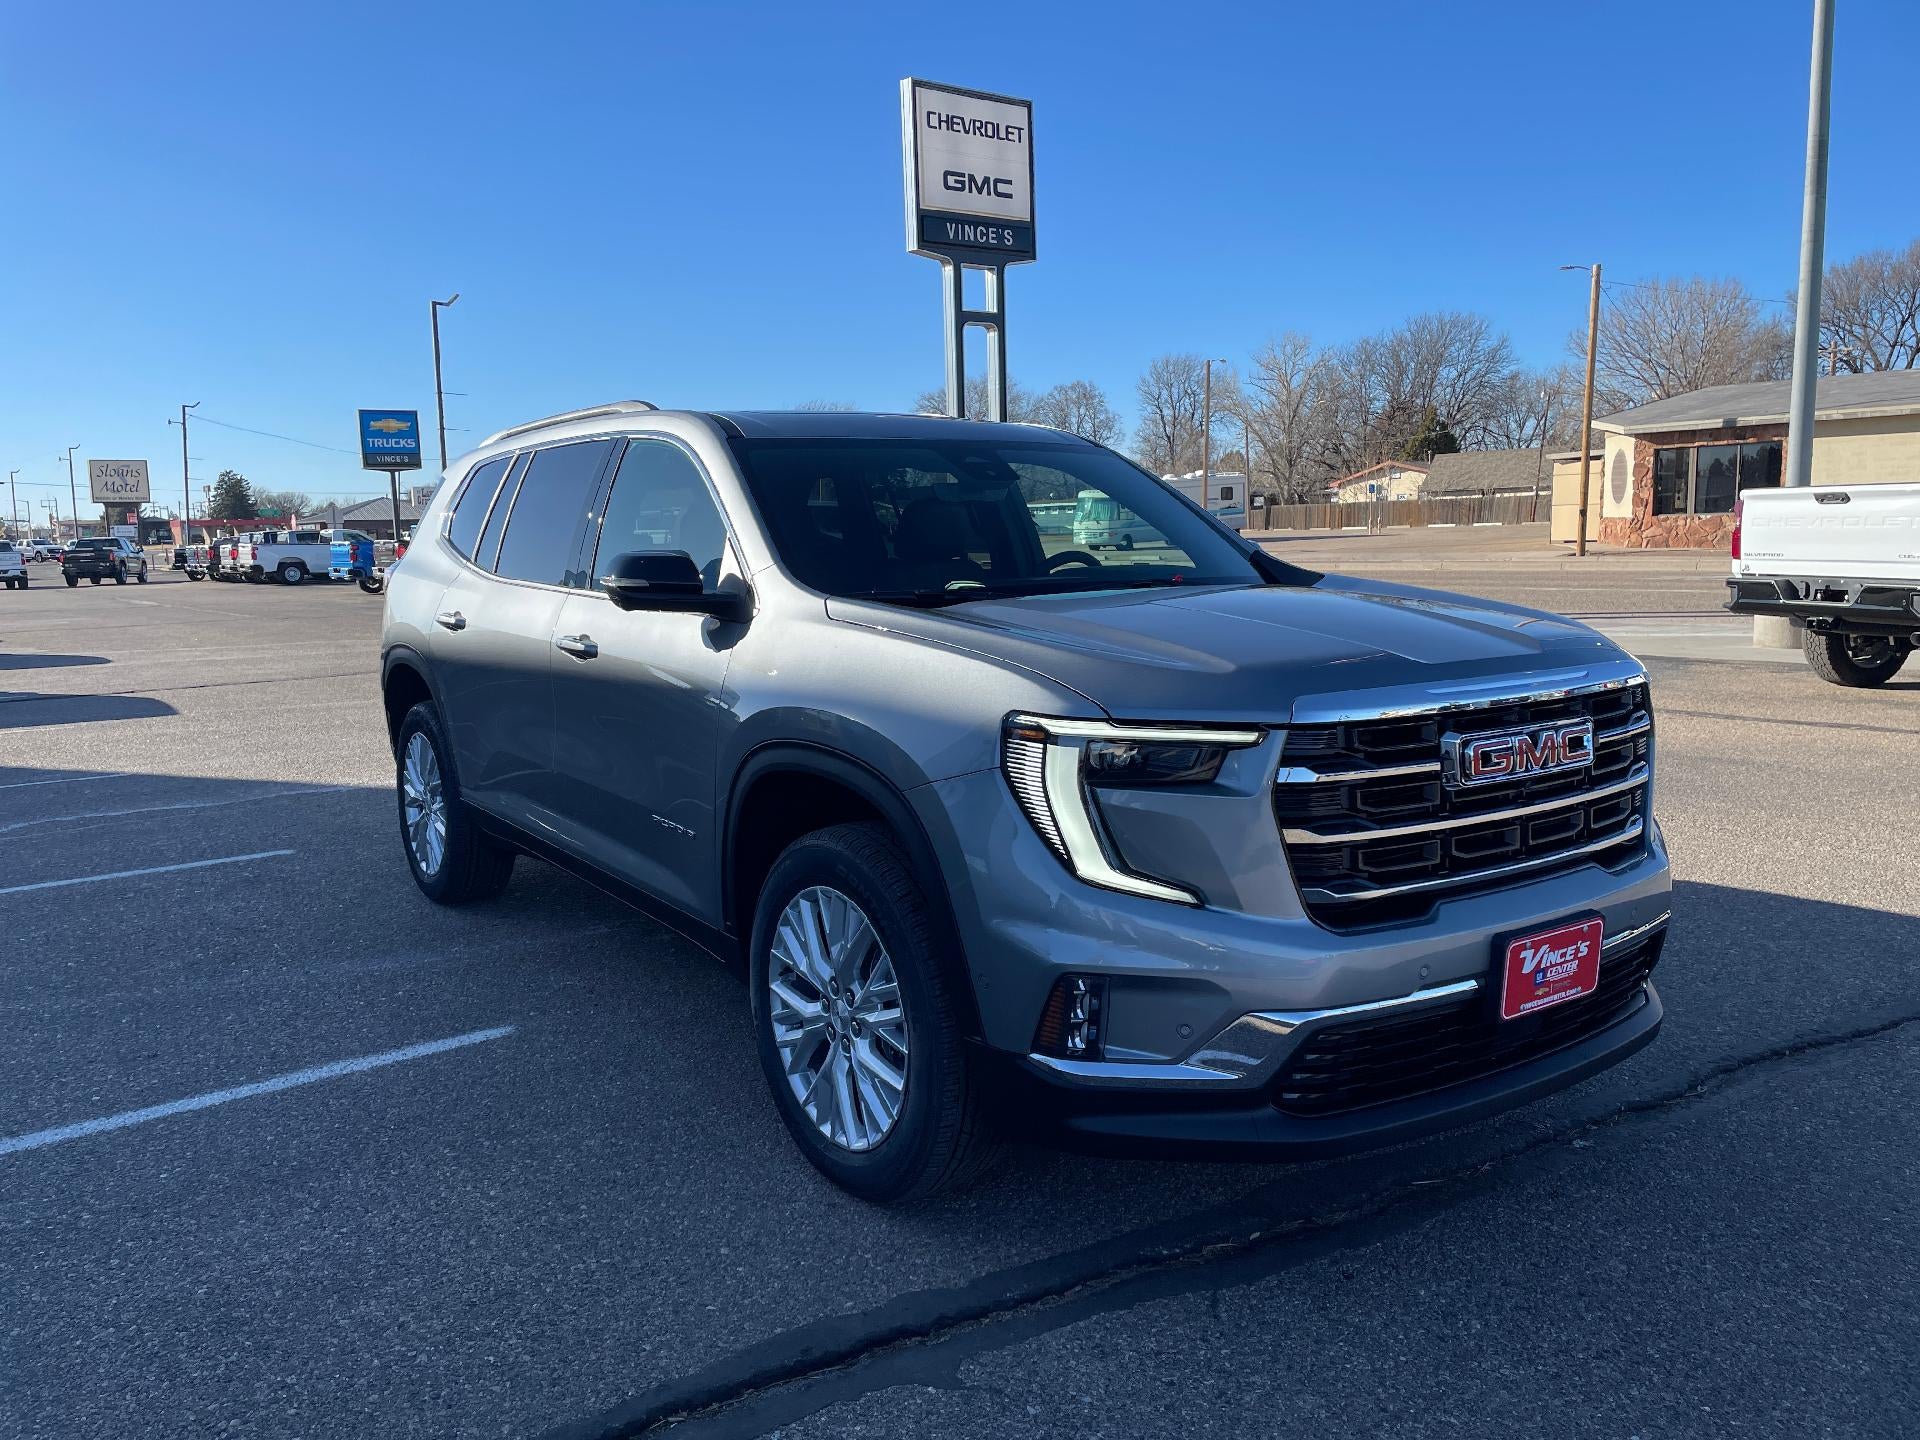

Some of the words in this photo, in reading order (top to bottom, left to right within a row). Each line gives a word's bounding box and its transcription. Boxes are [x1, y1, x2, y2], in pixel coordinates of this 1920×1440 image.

[926, 110, 1025, 144] CHEVROLET
[942, 169, 1014, 200] GMC
[946, 222, 1014, 246] VINCE'S
[366, 438, 416, 448] TRUCKS
[376, 455, 409, 463] VINCE'S
[96, 463, 141, 478] Sloans
[100, 479, 140, 493] Motel
[1471, 723, 1594, 777] GMC
[1546, 959, 1579, 978] CENTER
